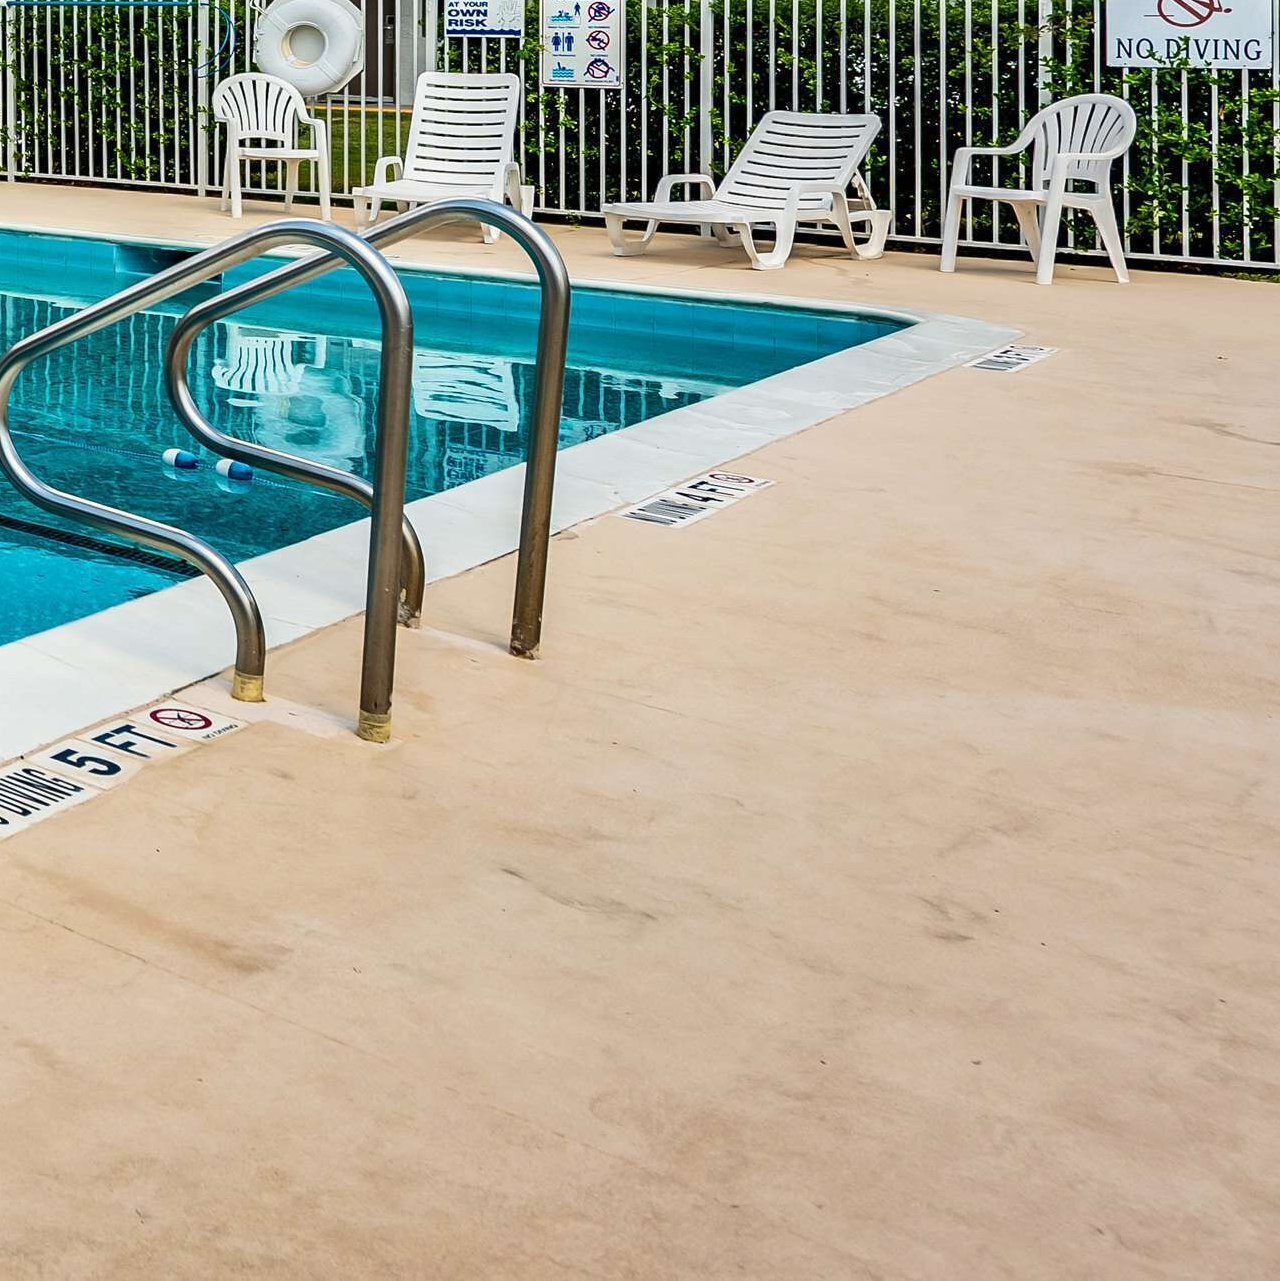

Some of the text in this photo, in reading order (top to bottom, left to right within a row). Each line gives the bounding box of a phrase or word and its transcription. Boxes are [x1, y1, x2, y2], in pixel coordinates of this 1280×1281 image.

[448, 9, 488, 17] OWN
[448, 19, 487, 27] RISK
[1116, 38, 1154, 59] NO
[687, 481, 745, 496] FT
[675, 491, 724, 503] 4
[50, 748, 122, 776] 5
[91, 723, 179, 759] FT
